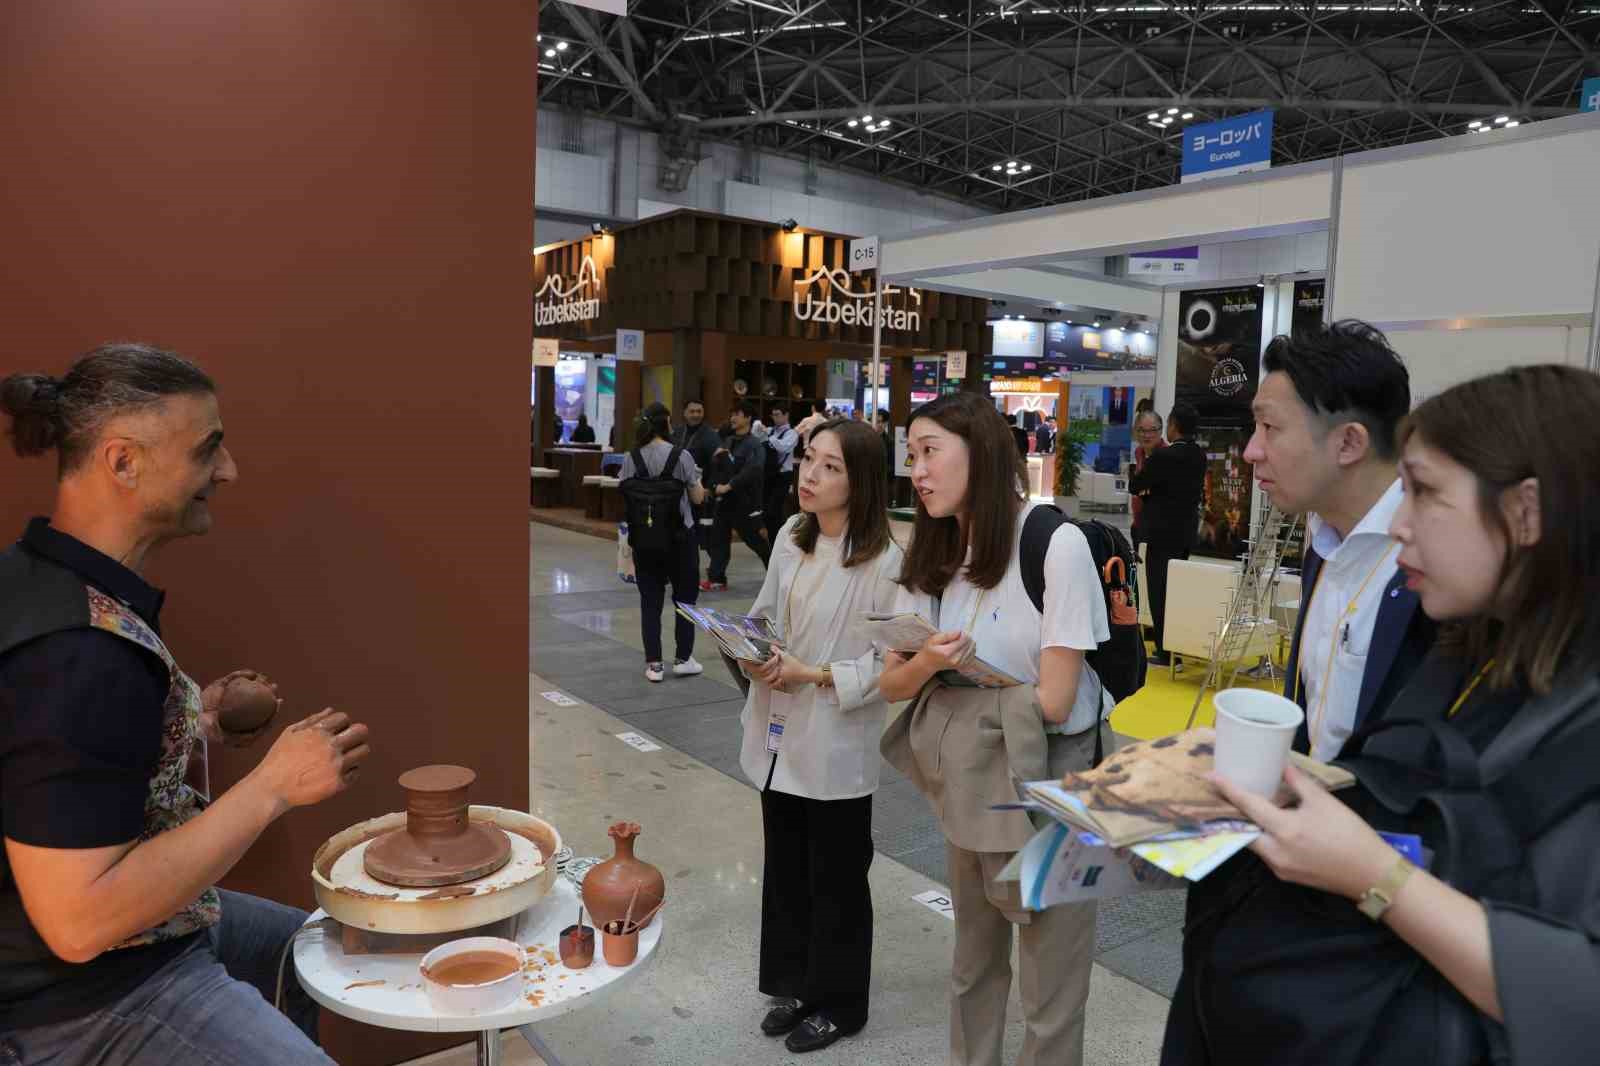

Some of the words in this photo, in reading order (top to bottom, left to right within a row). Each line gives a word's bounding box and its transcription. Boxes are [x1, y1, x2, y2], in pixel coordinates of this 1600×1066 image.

[1193, 122, 1263, 151] ヨーロッパ
[1209, 150, 1241, 163] Europe
[855, 247, 874, 260] C-15
[535, 297, 600, 327] Uzbekistan
[1209, 372, 1248, 388] ALGERIA
